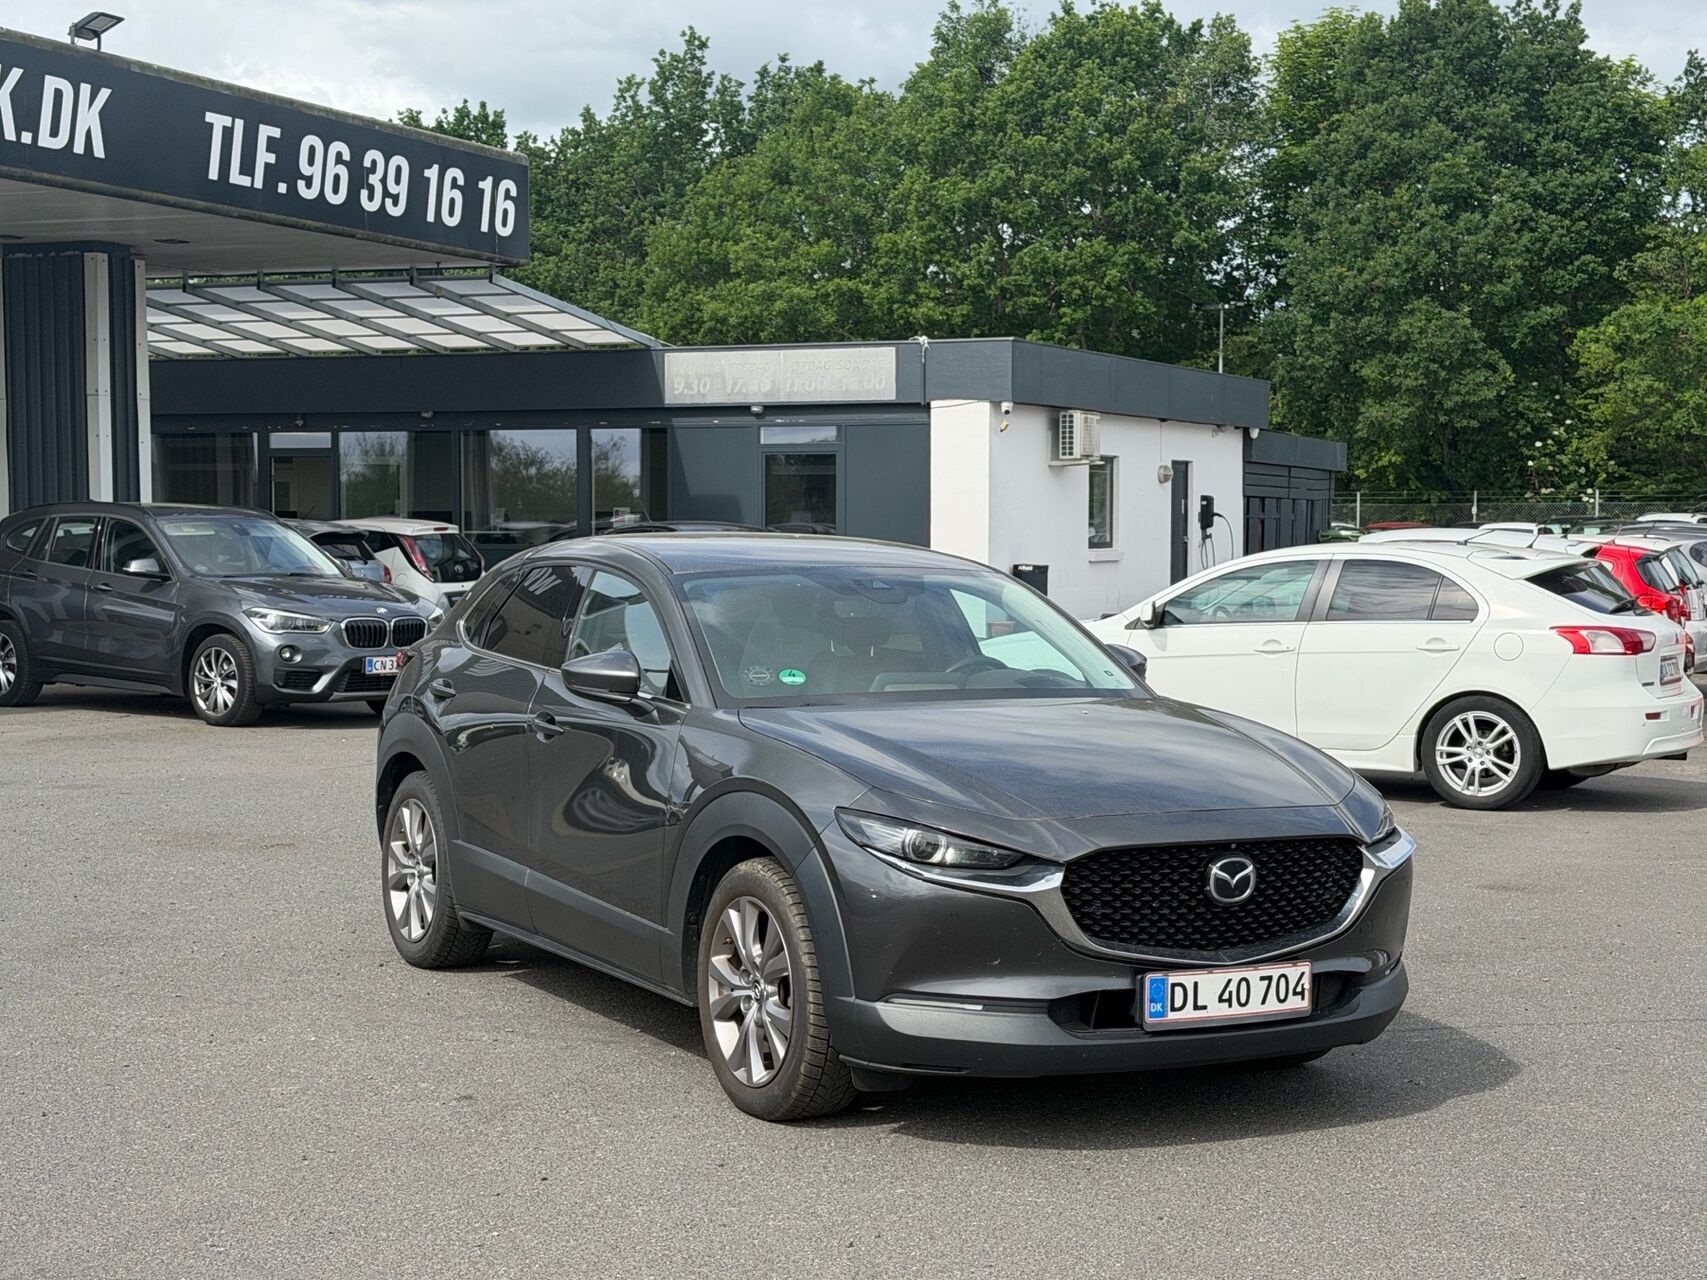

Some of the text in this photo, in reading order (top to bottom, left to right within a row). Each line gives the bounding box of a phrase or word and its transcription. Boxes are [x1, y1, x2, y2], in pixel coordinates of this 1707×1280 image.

[205, 111, 517, 237] TLF. 96 39 16 16
[374, 660, 387, 671] CN
[1170, 971, 1306, 1012] DL 40 704
[1150, 1003, 1164, 1013] DK
